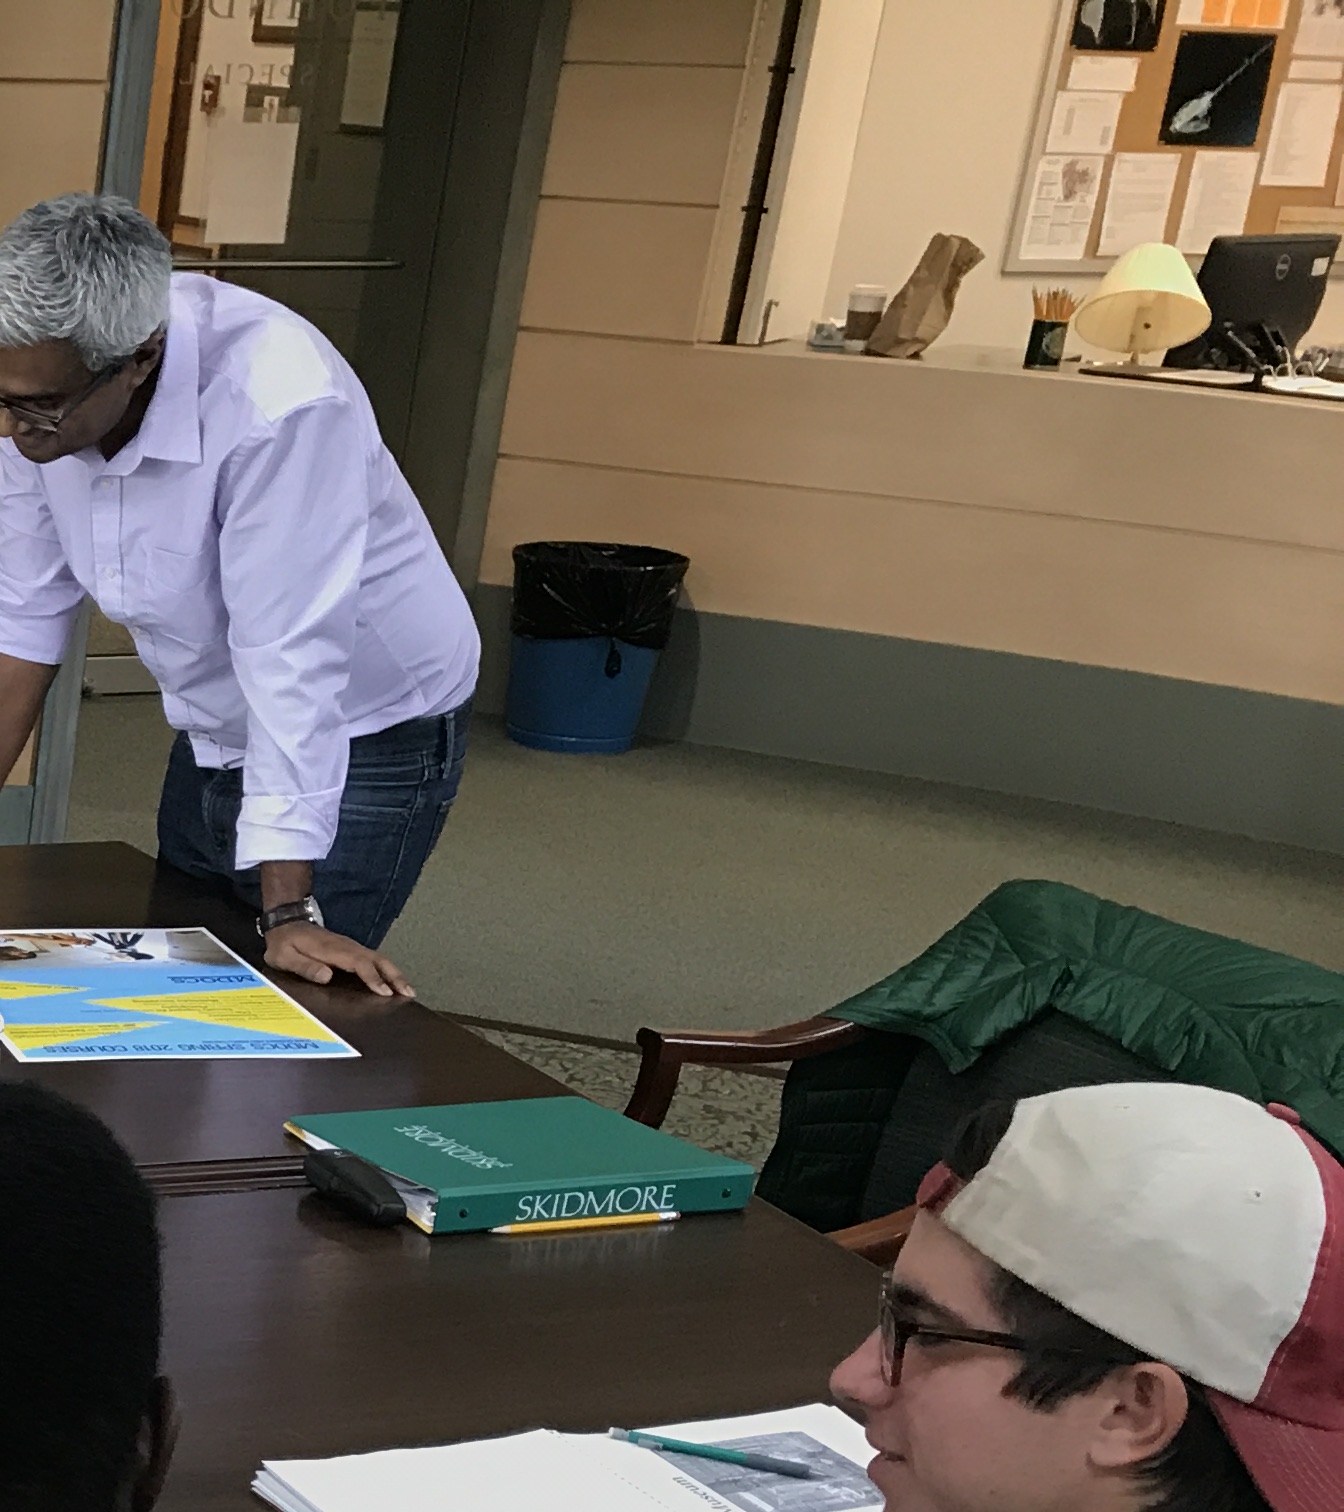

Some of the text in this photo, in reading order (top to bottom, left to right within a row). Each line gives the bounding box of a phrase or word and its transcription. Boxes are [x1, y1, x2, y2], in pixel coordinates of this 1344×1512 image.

[42, 1045, 129, 1053] COURSES
[177, 1043, 246, 1052] SPRING
[515, 1184, 677, 1223] SKIDMORE
